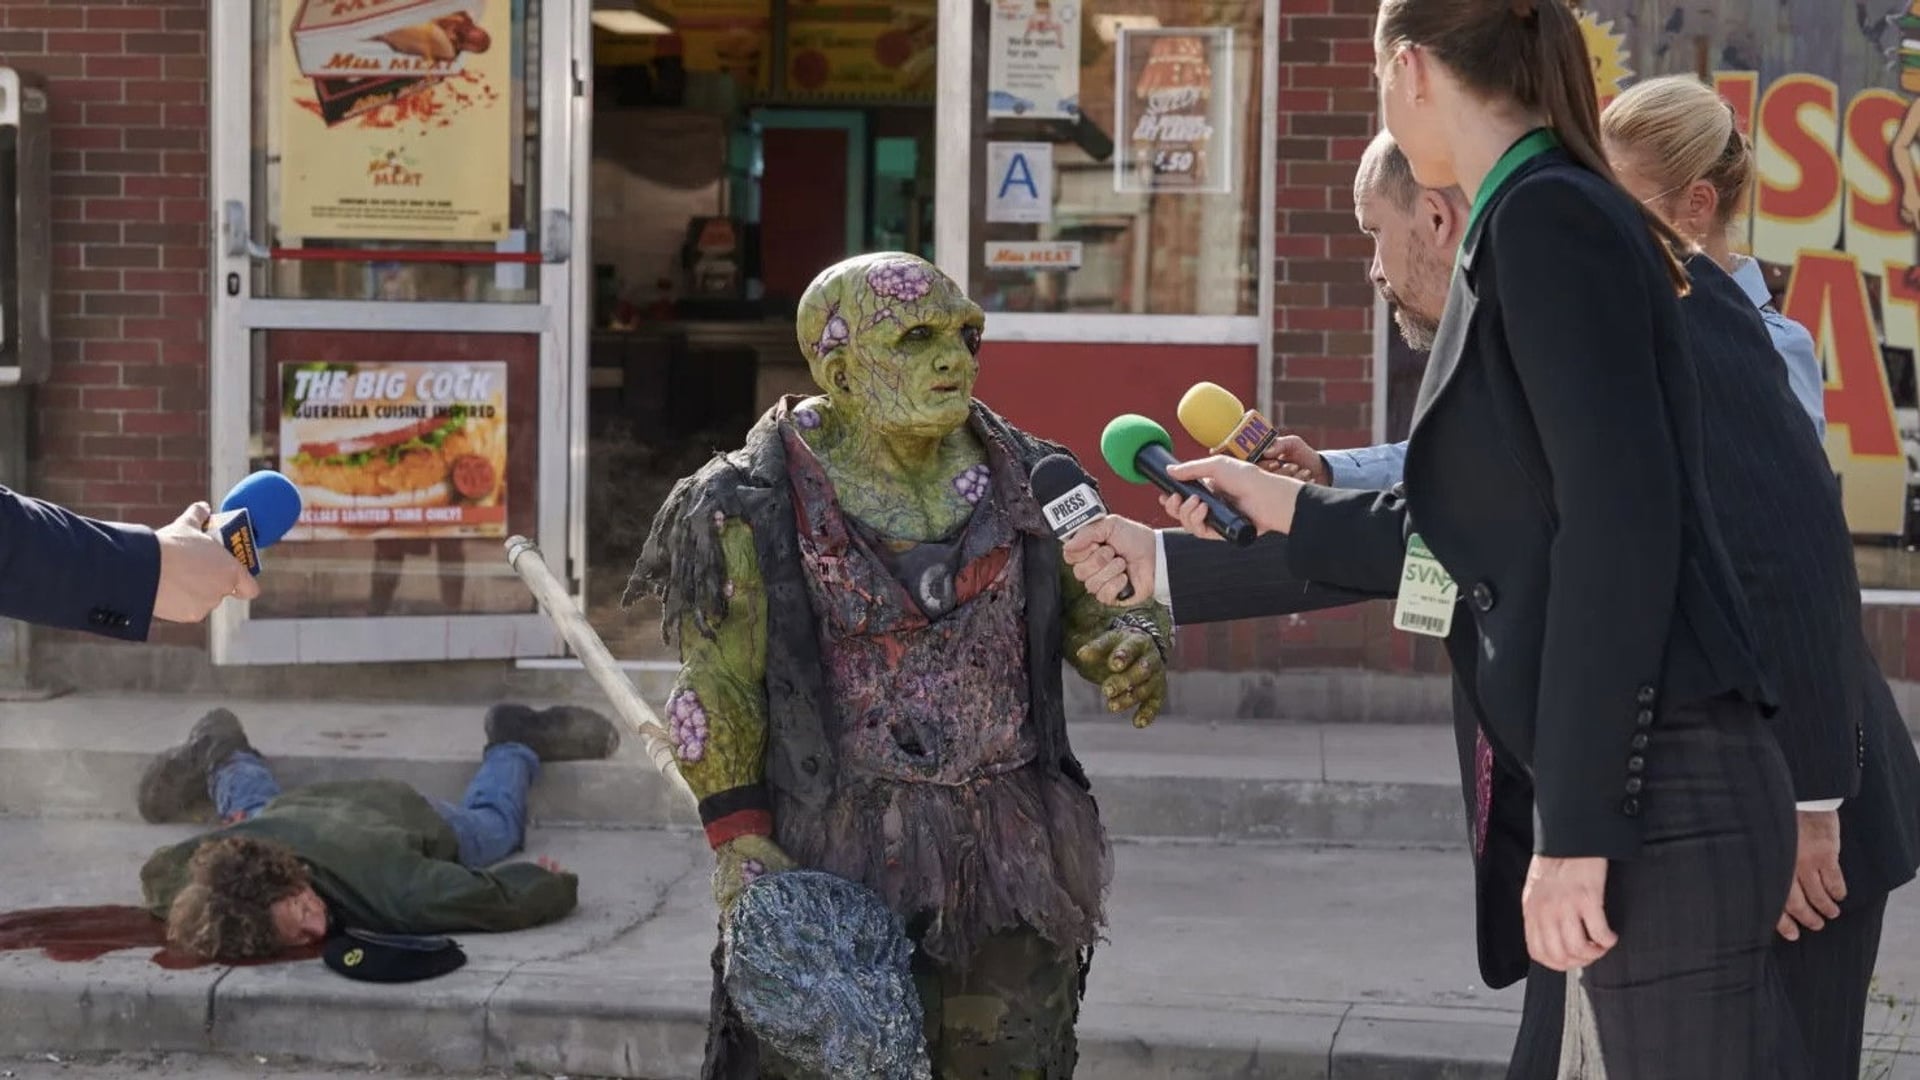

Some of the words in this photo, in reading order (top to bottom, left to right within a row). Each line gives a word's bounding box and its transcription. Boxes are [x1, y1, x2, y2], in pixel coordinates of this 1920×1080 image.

[999, 153, 1038, 198] A
[294, 370, 348, 400] THE
[354, 371, 406, 400] BIG
[416, 372, 492, 400] COCK
[295, 404, 369, 418] GUERRILLA
[374, 405, 427, 418] CUISINE
[433, 405, 496, 418] INSPIRED
[1052, 493, 1085, 521] PRESS
